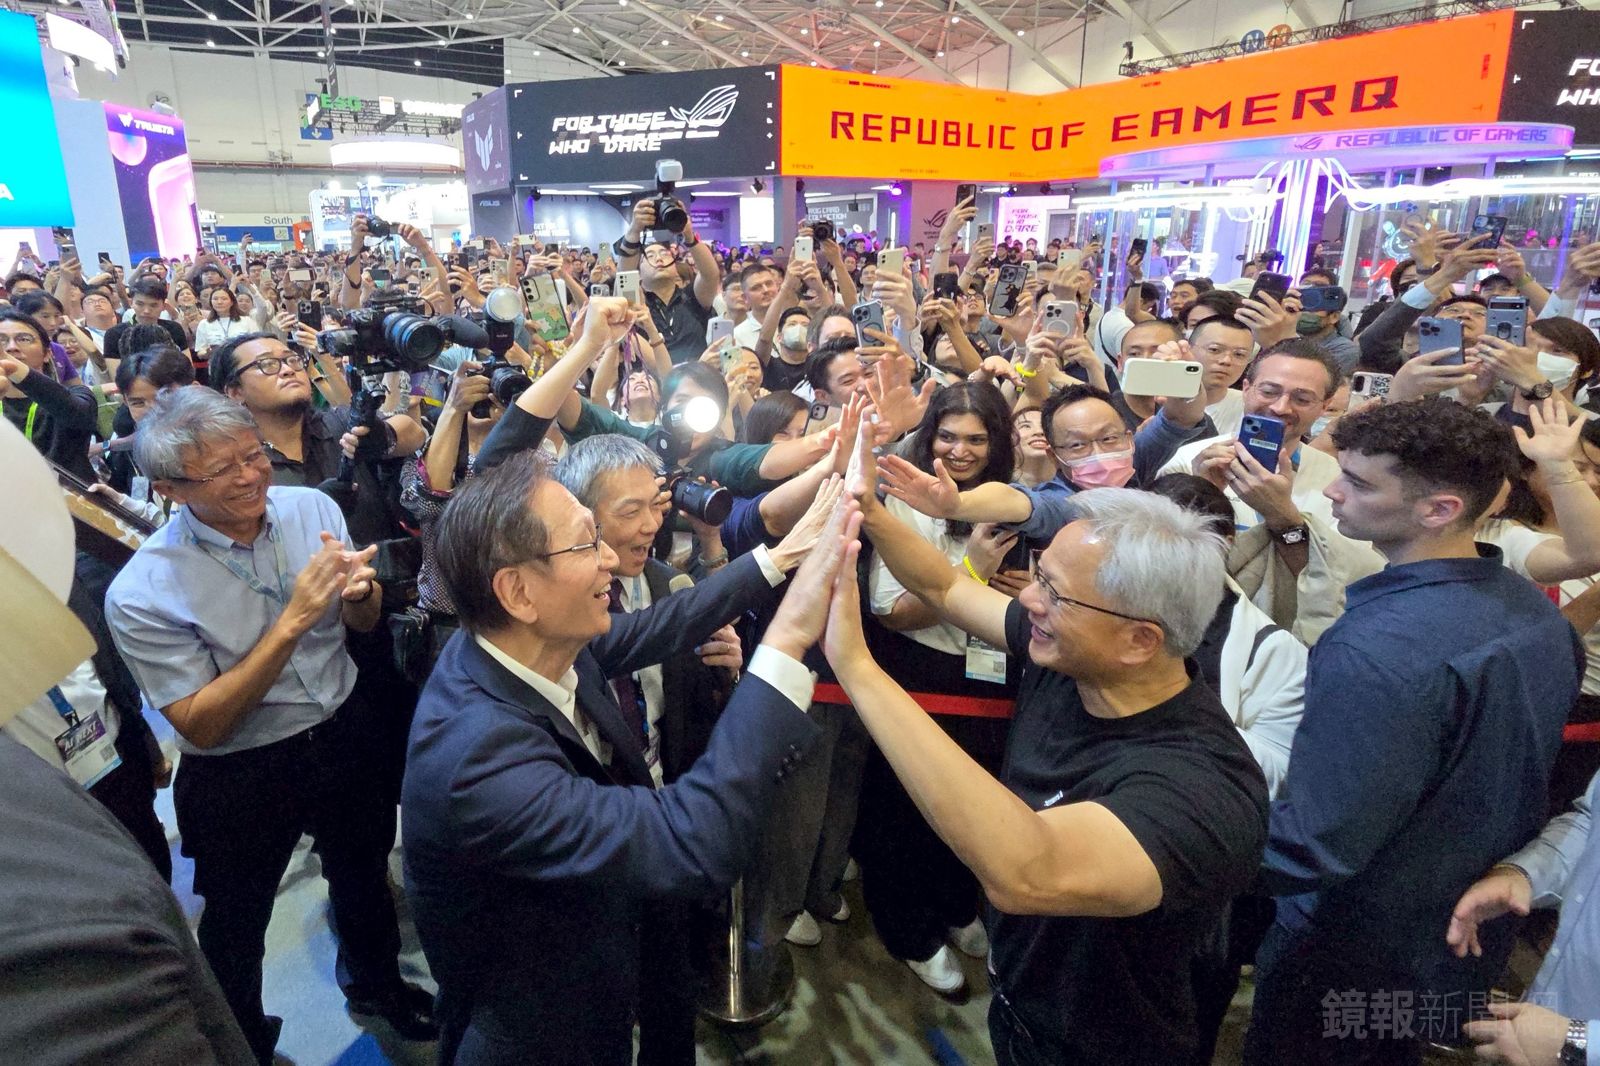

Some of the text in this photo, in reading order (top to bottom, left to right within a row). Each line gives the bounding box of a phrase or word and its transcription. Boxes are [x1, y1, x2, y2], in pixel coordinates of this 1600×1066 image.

[831, 75, 1399, 152] REPUBLIC OF EAMERQ
[549, 138, 663, 155] WHO DARE
[1335, 128, 1548, 148] REPUBLIC OF GAMERS
[263, 215, 294, 225] South
[1004, 224, 1039, 233] DARE
